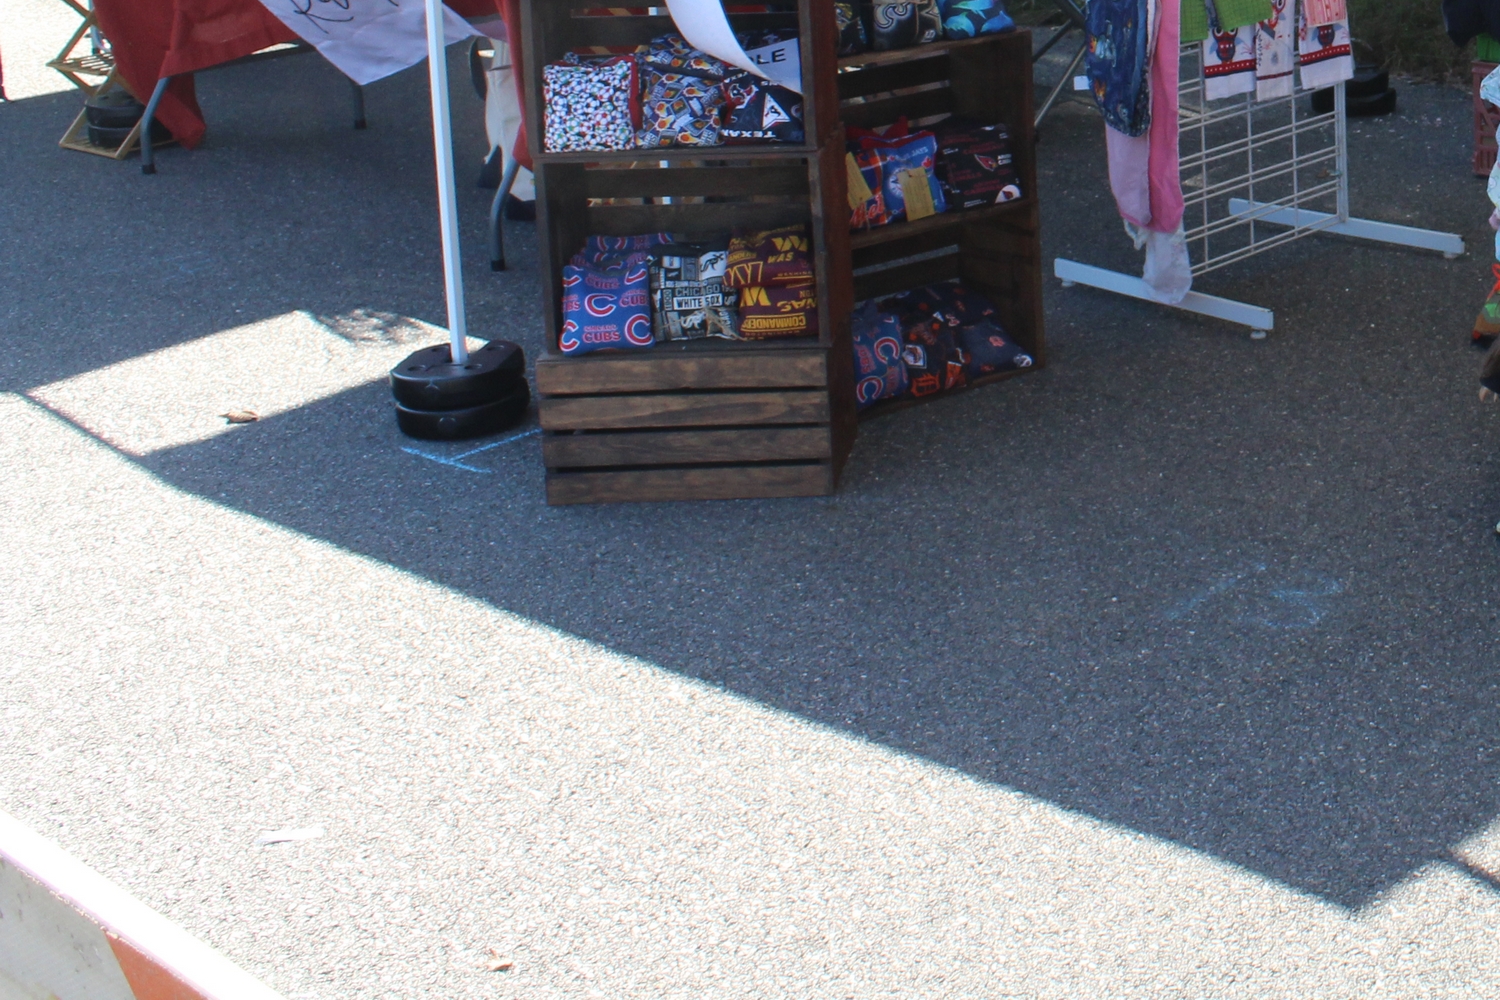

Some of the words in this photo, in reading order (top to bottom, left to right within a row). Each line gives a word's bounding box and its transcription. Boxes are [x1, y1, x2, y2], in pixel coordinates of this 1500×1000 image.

[675, 283, 721, 297] CHICAGO
[676, 297, 703, 310] WHITE
[705, 293, 721, 307] SOX
[582, 331, 622, 343] CUBS
